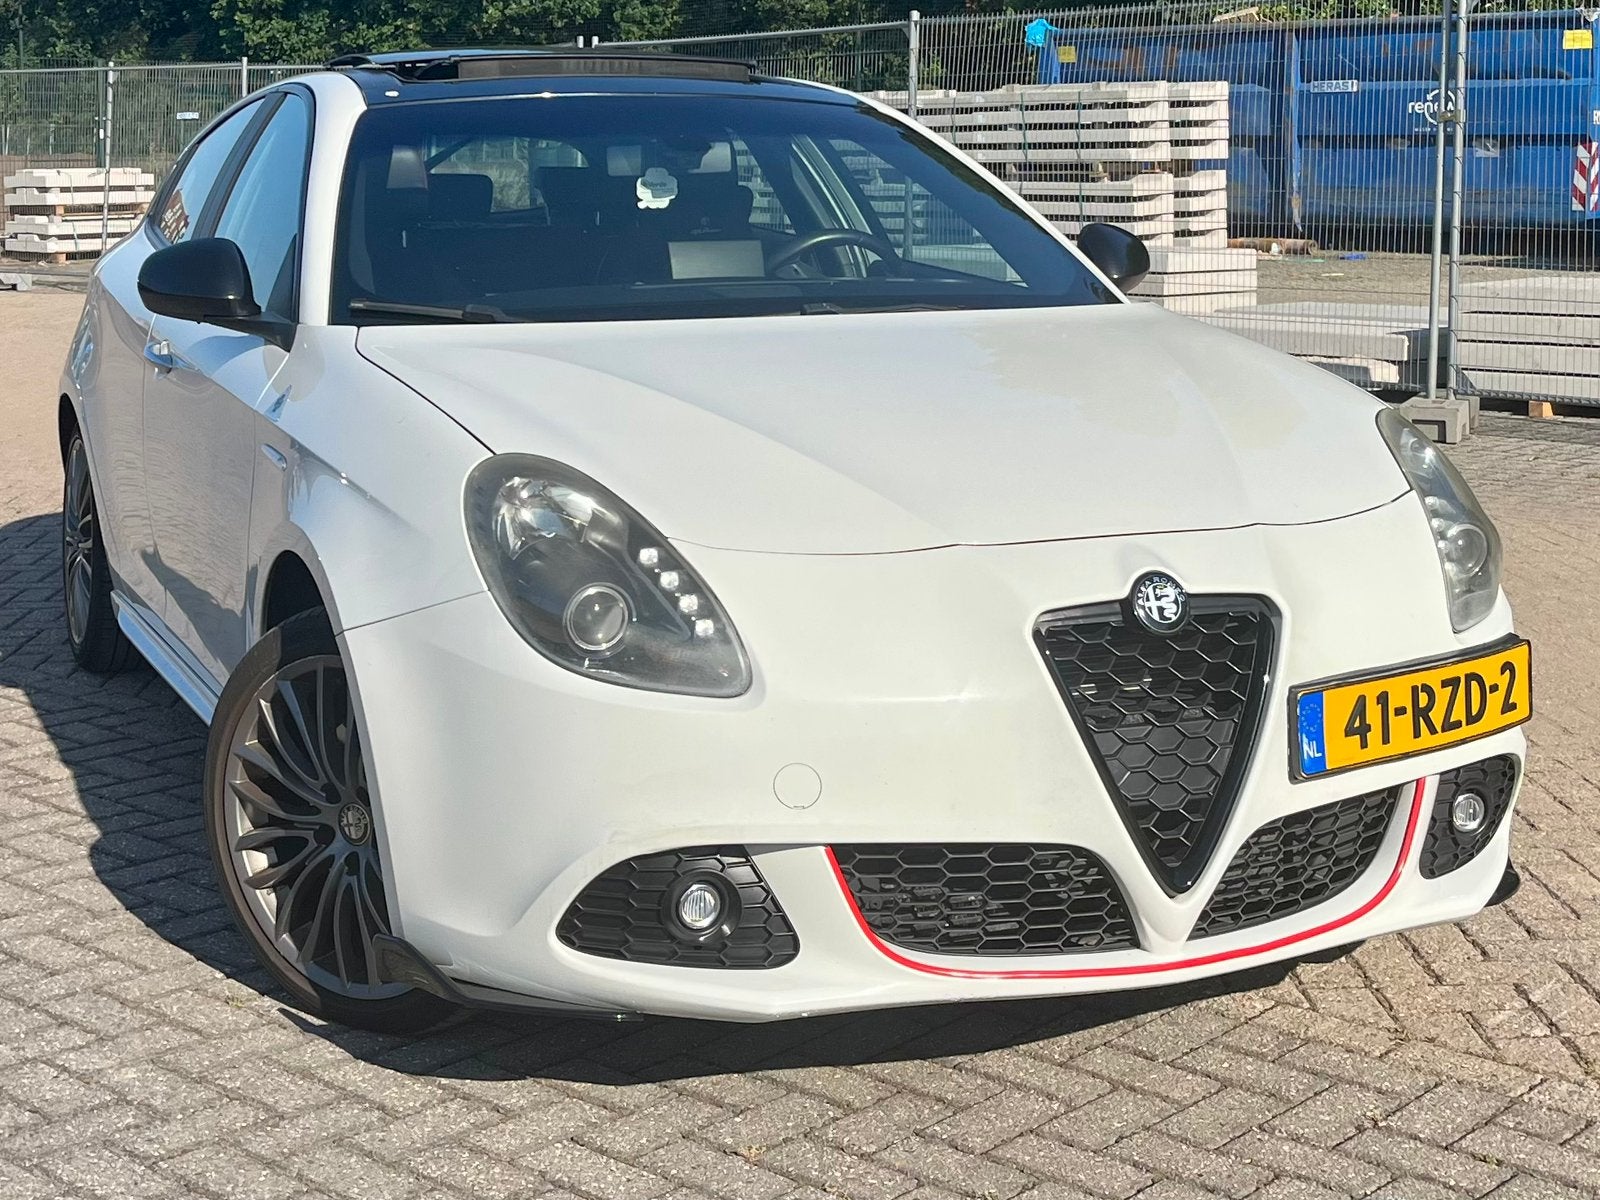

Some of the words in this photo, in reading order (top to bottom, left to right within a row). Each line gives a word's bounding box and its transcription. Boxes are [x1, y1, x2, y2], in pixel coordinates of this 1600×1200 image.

[1312, 80, 1350, 92] HERAS
[1343, 659, 1518, 750] 41-RZD-2
[1302, 734, 1323, 760] NL
